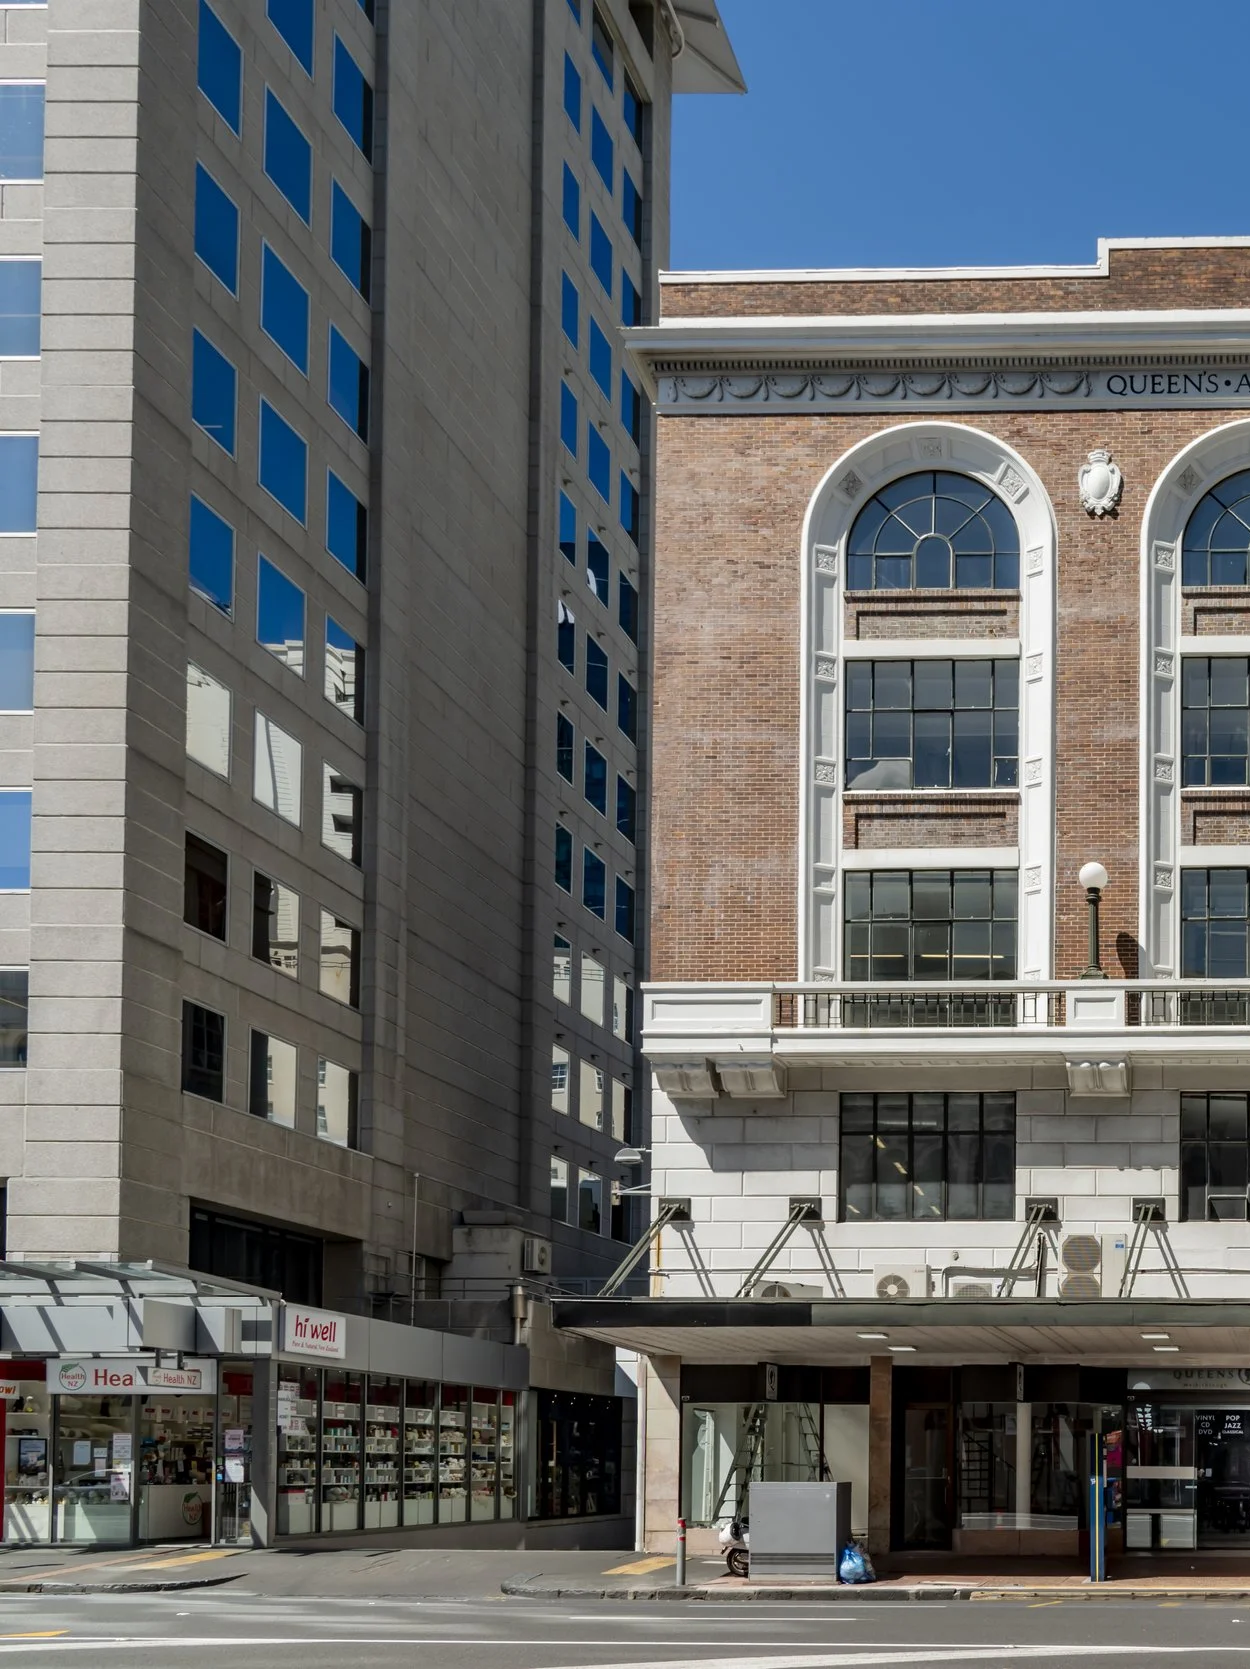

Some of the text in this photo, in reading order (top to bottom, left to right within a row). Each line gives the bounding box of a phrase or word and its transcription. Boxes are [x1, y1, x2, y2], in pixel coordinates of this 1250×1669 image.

[1106, 369, 1219, 396] QUEEN'S
[295, 1314, 337, 1343] hi well
[61, 1372, 85, 1380] Health
[94, 1368, 134, 1387] Hea
[163, 1373, 185, 1385] Health
[187, 1375, 197, 1386] NZ
[1173, 1369, 1234, 1380] QUEENS
